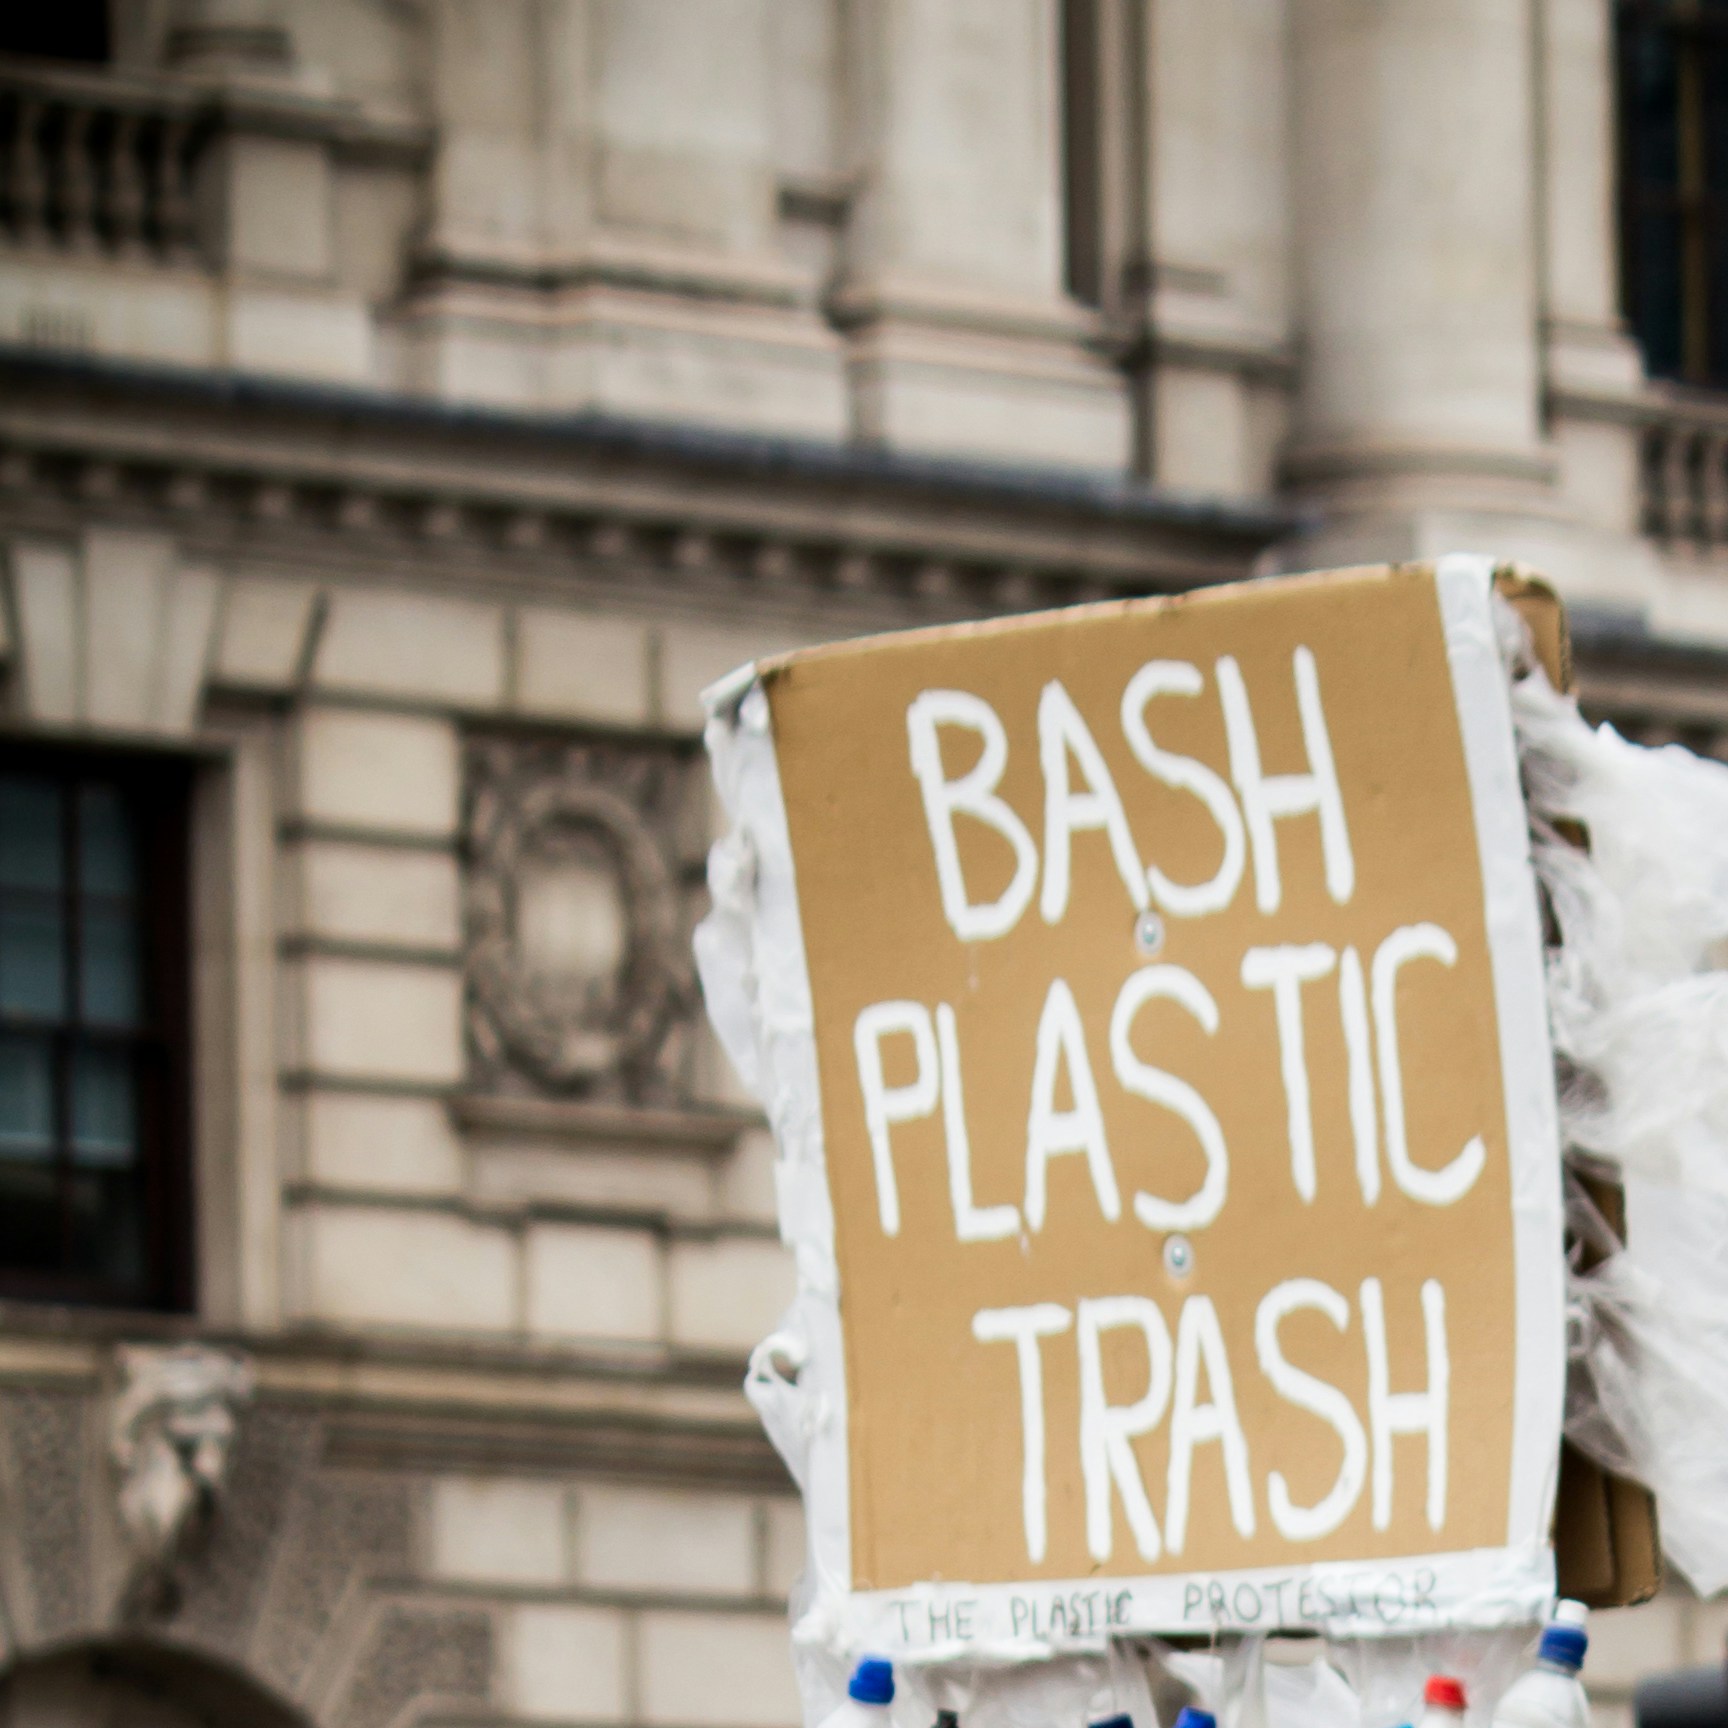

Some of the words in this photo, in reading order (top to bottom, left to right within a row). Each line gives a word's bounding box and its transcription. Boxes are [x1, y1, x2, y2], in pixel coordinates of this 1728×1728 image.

[906, 645, 1355, 942] BASH
[853, 921, 1487, 1242] PLASTIC
[971, 1276, 1452, 1567] TRASH
[894, 1598, 978, 1643] THE
[1009, 1588, 1135, 1639] PLASTIC
